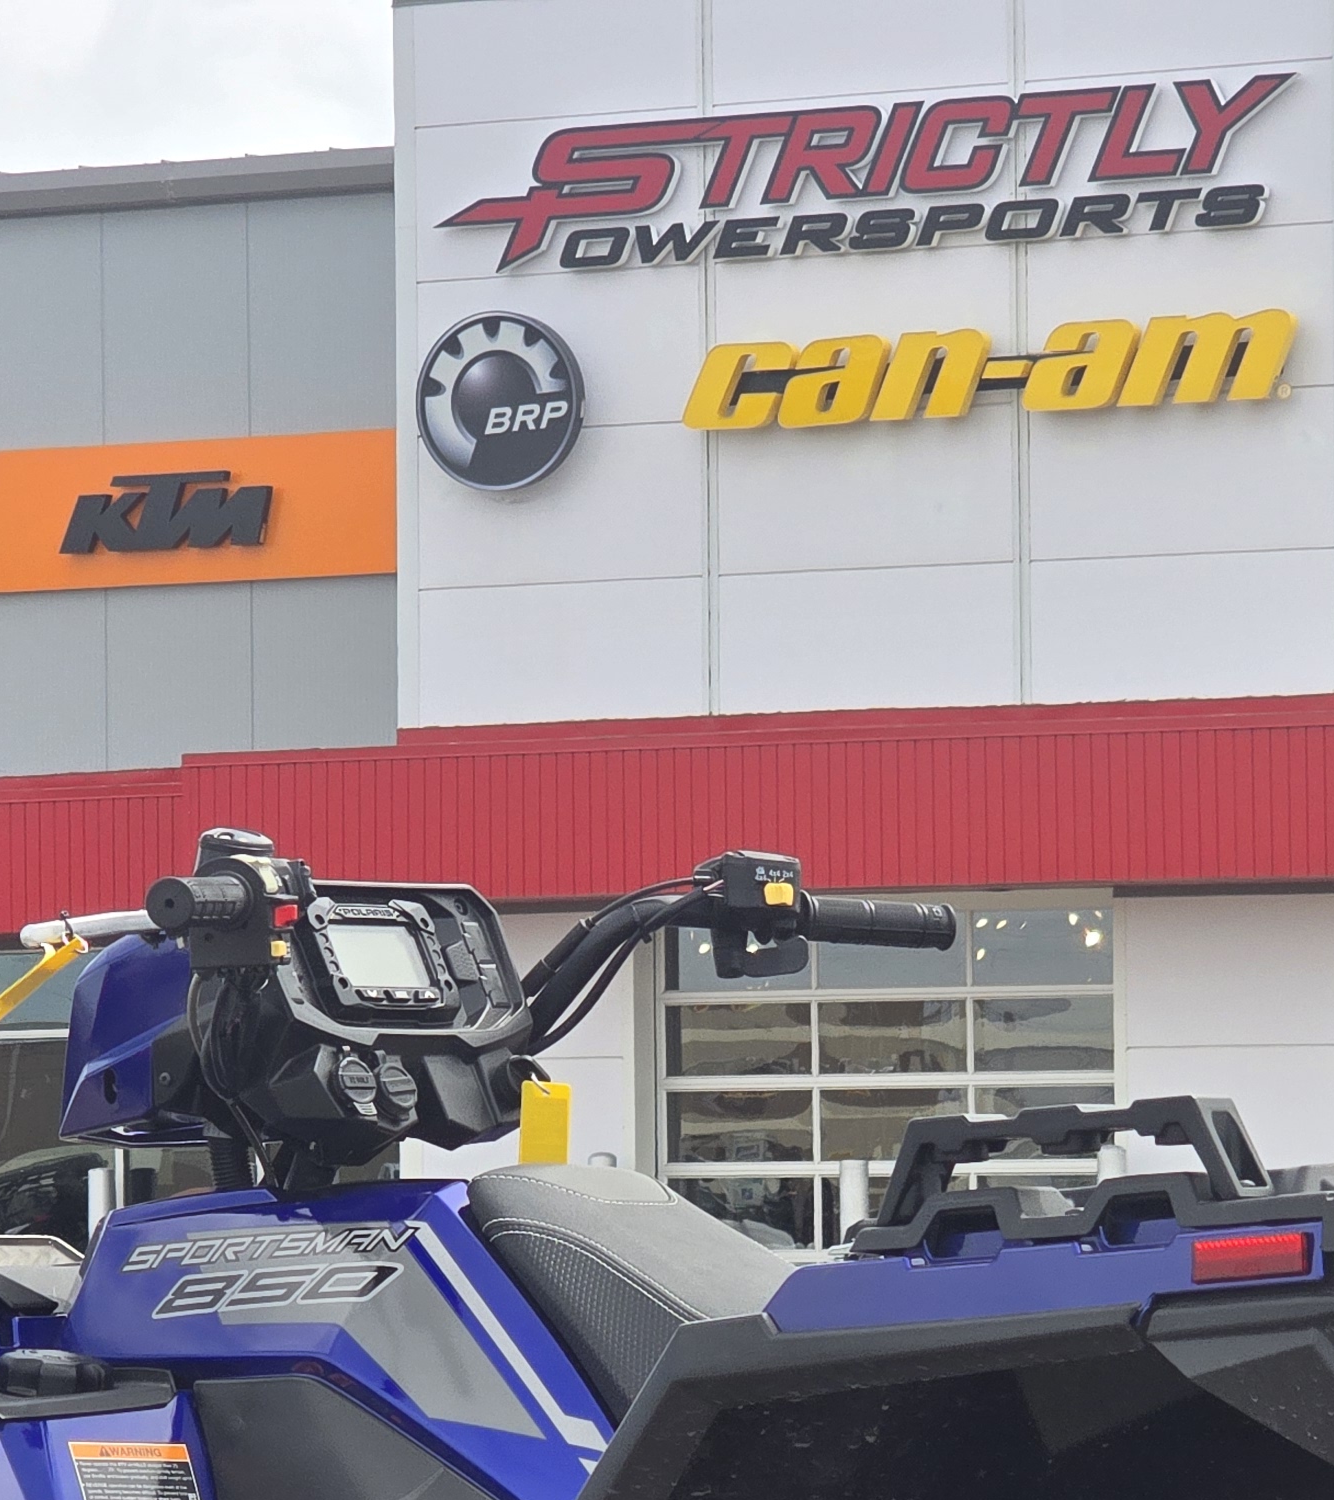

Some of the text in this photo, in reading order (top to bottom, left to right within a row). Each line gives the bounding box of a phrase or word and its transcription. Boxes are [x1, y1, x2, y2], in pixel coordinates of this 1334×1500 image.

[434, 72, 1299, 228] STRICTLY
[484, 401, 569, 435] BRP
[58, 470, 274, 555] KTM
[342, 908, 394, 918] POLARIS
[121, 1225, 419, 1273] SPORTSMAN
[151, 1261, 405, 1320] 850
[110, 1447, 162, 1457] WARNING
